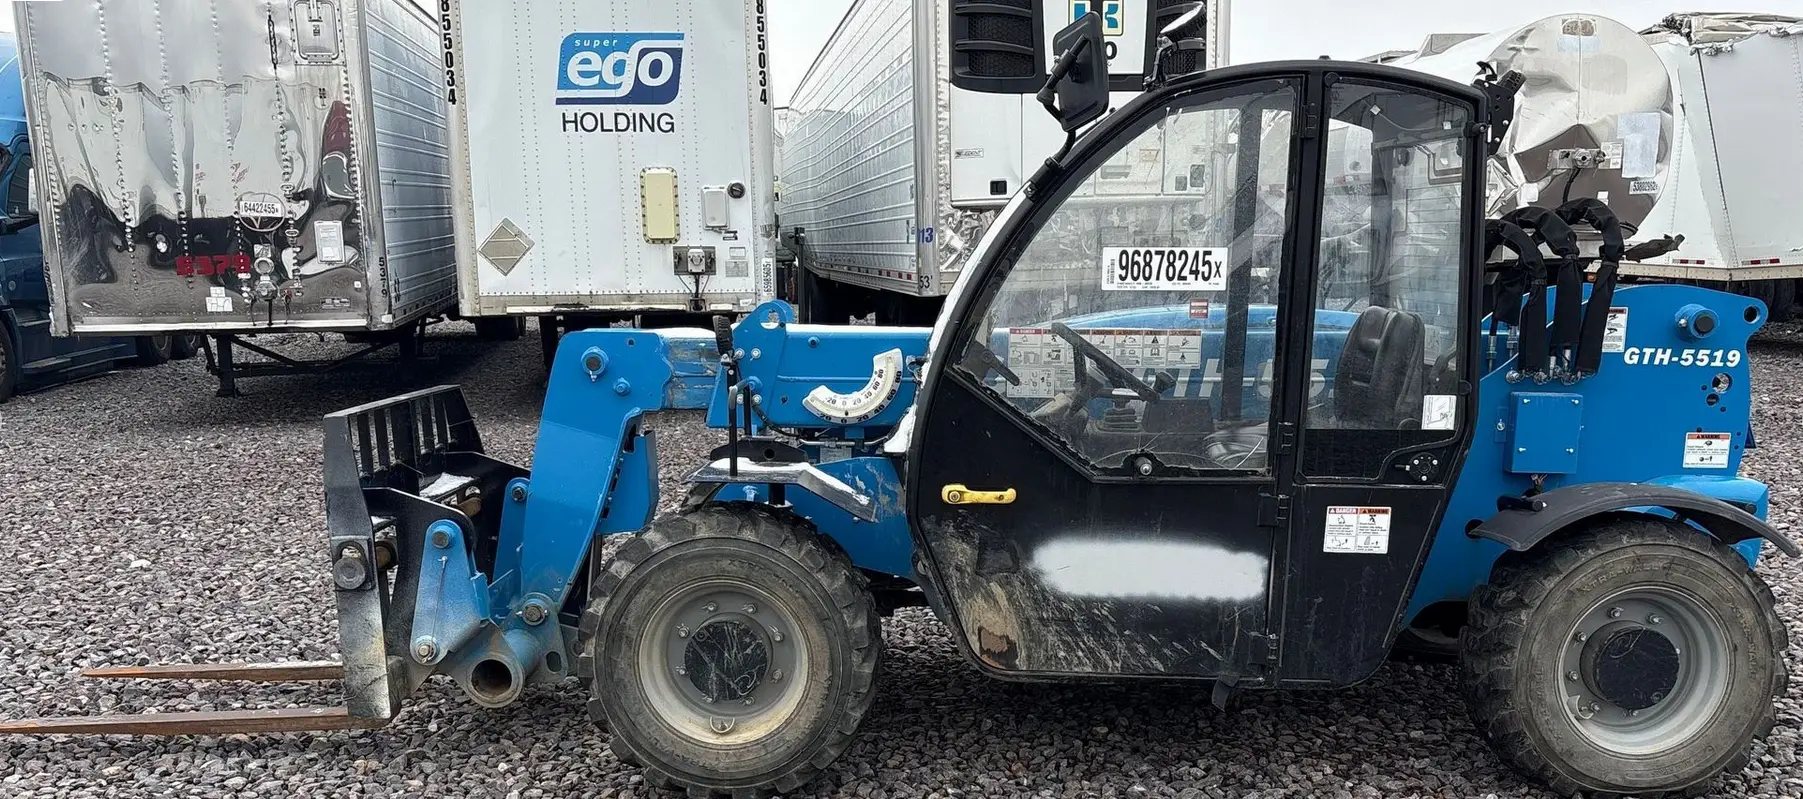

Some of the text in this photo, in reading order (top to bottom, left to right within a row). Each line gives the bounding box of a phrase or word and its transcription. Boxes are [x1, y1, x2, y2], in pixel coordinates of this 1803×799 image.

[574, 39, 618, 48] super
[566, 50, 674, 96] ego
[561, 111, 676, 133] HOLDING
[1623, 346, 1741, 367] GTH-5519
